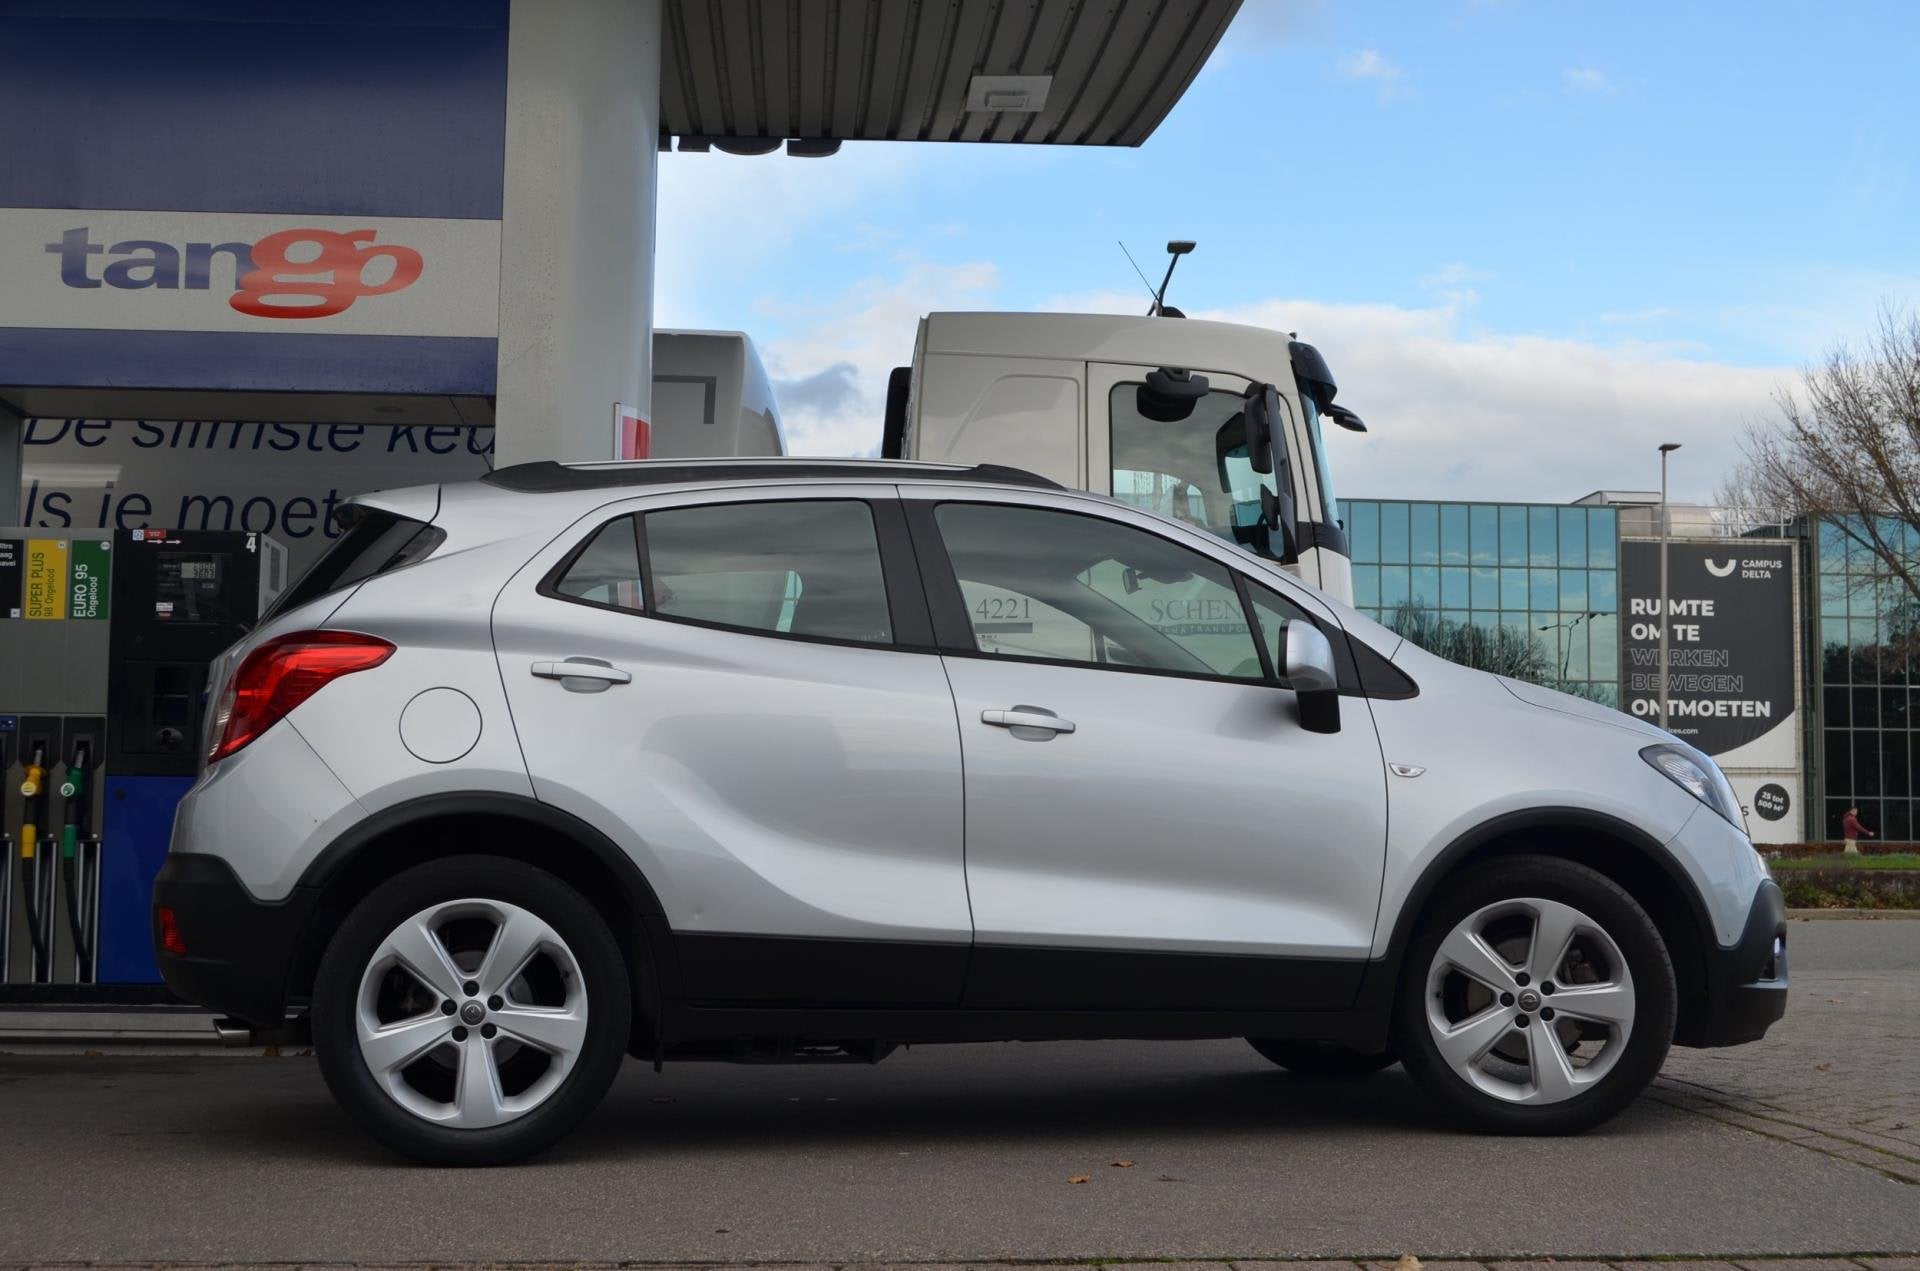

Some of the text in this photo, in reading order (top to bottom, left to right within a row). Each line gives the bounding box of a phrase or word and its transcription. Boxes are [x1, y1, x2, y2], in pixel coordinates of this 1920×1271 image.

[44, 226, 425, 320] tango
[177, 488, 341, 539] moet
[246, 536, 258, 553] 4
[1741, 559, 1783, 569] CAMPUS
[1741, 569, 1772, 579] DELTA
[29, 552, 45, 617] SUPER PLUS
[45, 568, 56, 604] Ongelood
[73, 563, 88, 618] EURO 95
[87, 576, 99, 618] Ongelood
[1630, 598, 1715, 617] RUMTE
[975, 598, 1032, 619] 4221
[1149, 598, 1262, 621] SCHEN
[1630, 623, 1701, 641] OM TE
[1631, 673, 1744, 693] BEWEGEN
[1630, 698, 1771, 718] ONTMOETEN
